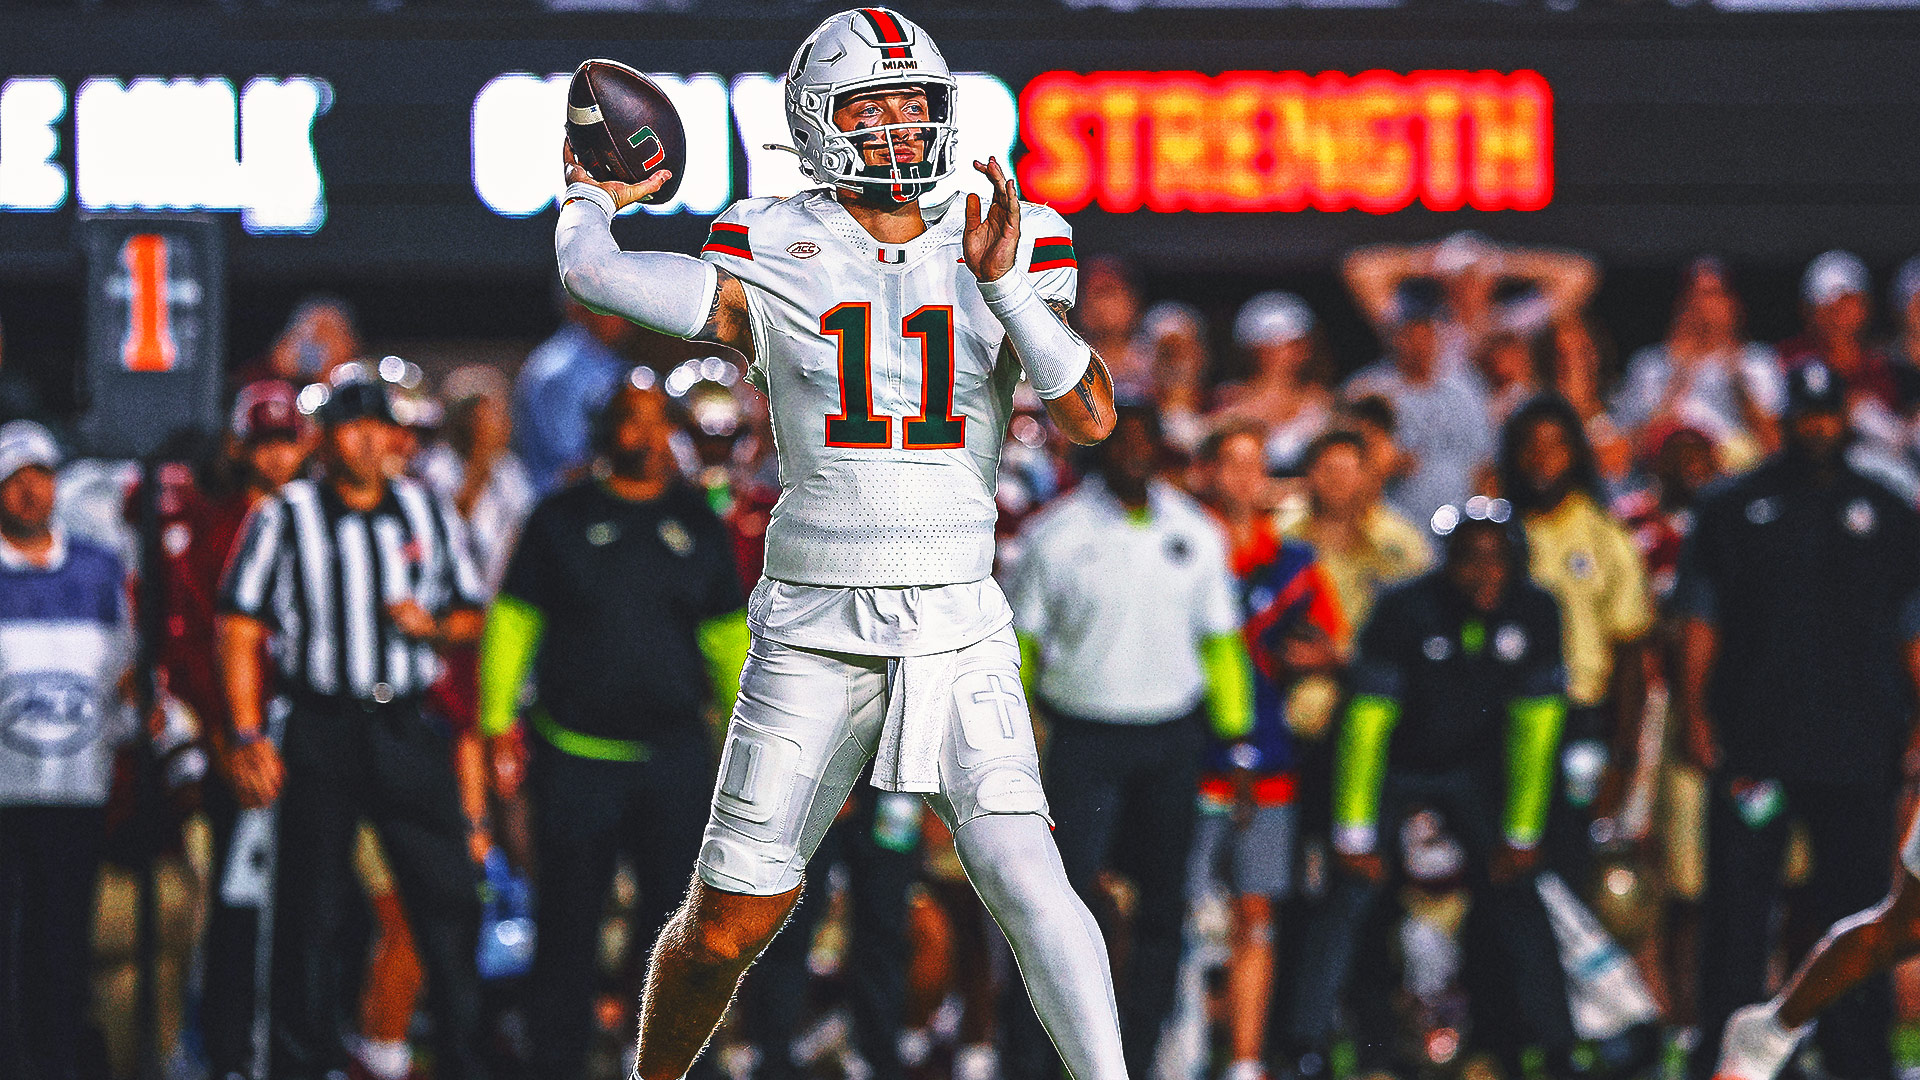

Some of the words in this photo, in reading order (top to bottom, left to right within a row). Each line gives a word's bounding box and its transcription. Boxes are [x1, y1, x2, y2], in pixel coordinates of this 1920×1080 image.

[882, 60, 918, 70] MIAMI
[890, 166, 922, 202] U
[1017, 69, 1554, 213] STRENGTH
[877, 247, 906, 264] U
[124, 233, 177, 372] 1
[819, 301, 968, 450] 11
